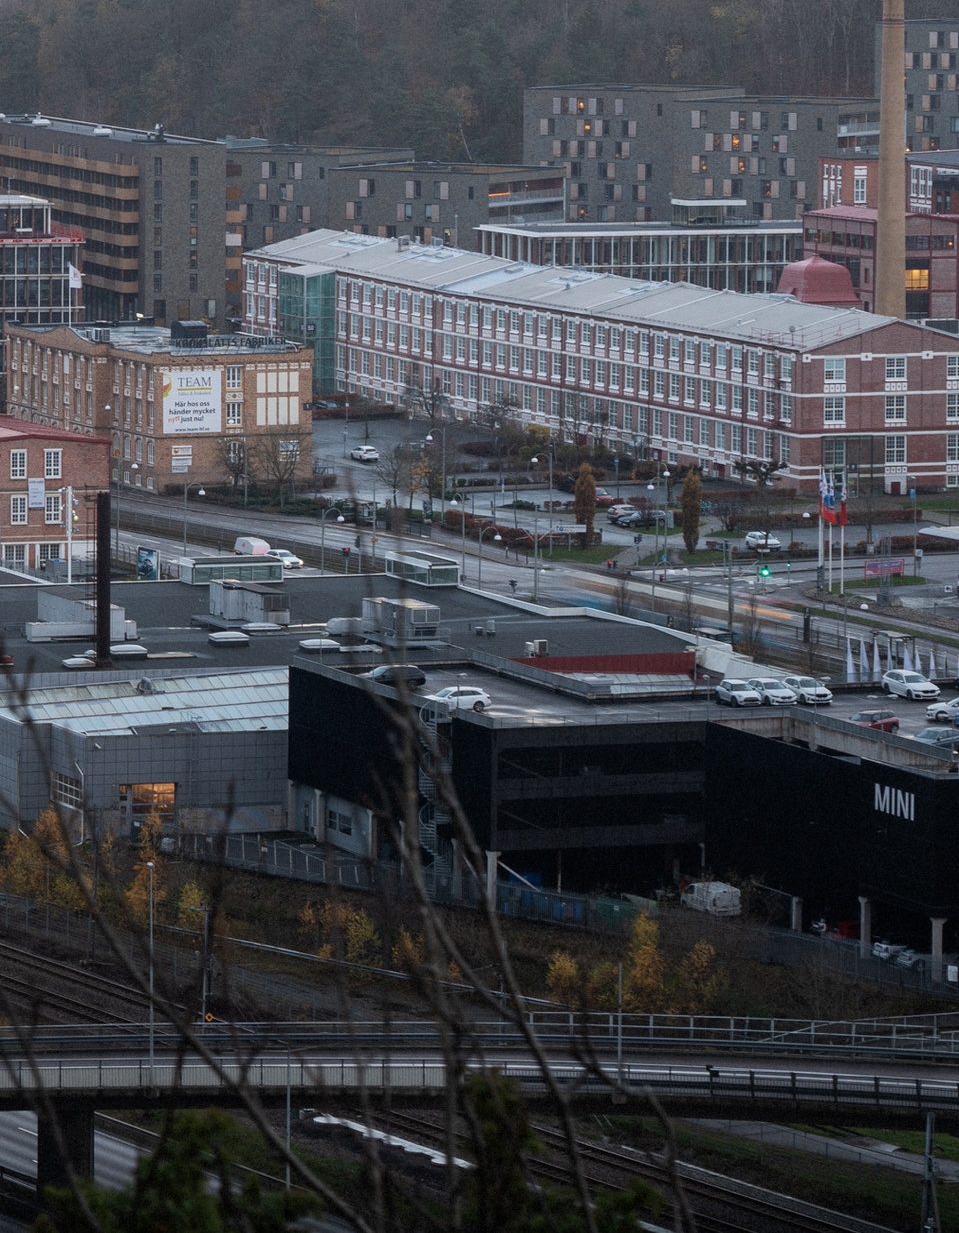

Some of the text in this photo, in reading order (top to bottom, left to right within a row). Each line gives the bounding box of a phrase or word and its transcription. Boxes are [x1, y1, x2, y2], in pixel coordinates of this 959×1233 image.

[175, 336, 287, 348] KROKSLÄTTS FABRIKER
[177, 376, 212, 388] TEAM
[167, 416, 180, 424] nytt
[875, 782, 914, 821] MINI
